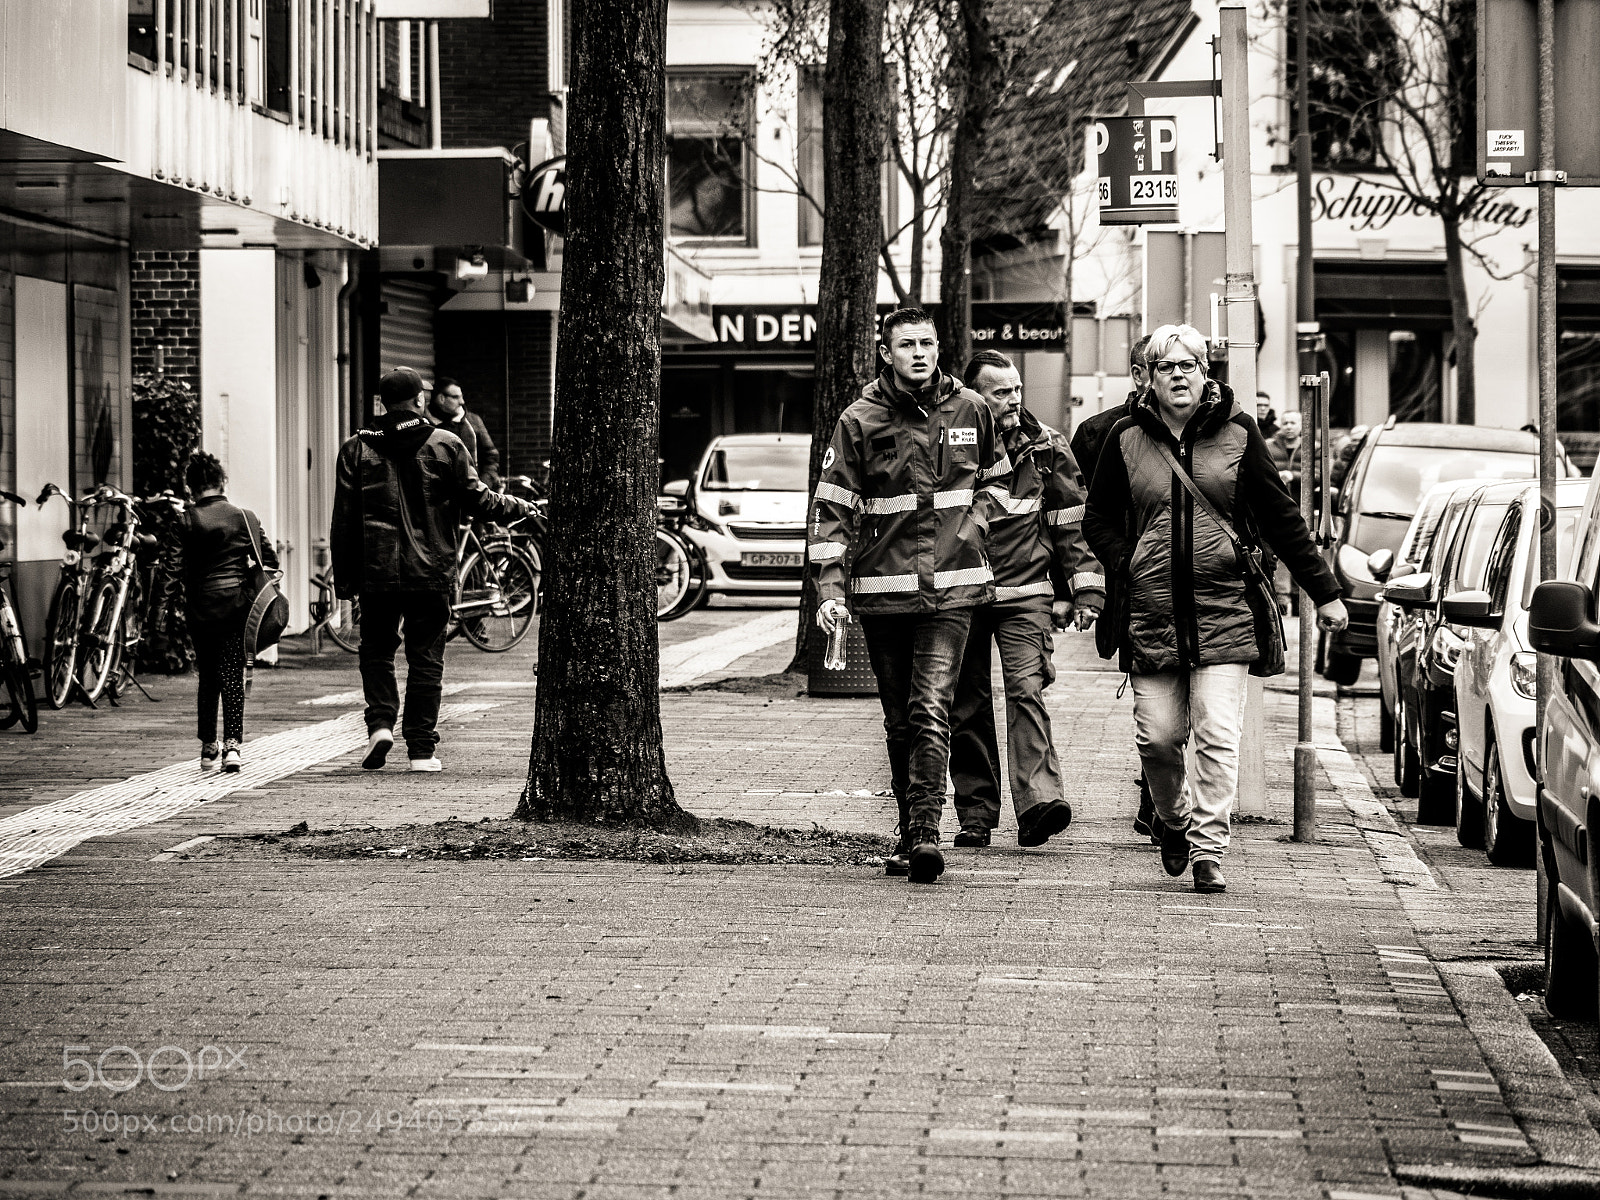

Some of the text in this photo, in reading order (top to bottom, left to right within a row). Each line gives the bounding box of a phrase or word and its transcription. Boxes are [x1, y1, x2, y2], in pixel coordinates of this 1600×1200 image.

[1150, 119, 1177, 171] P
[535, 170, 566, 212] h
[1133, 180, 1177, 199] 23156
[1002, 323, 1014, 340] &
[1018, 323, 1068, 340] beaut
